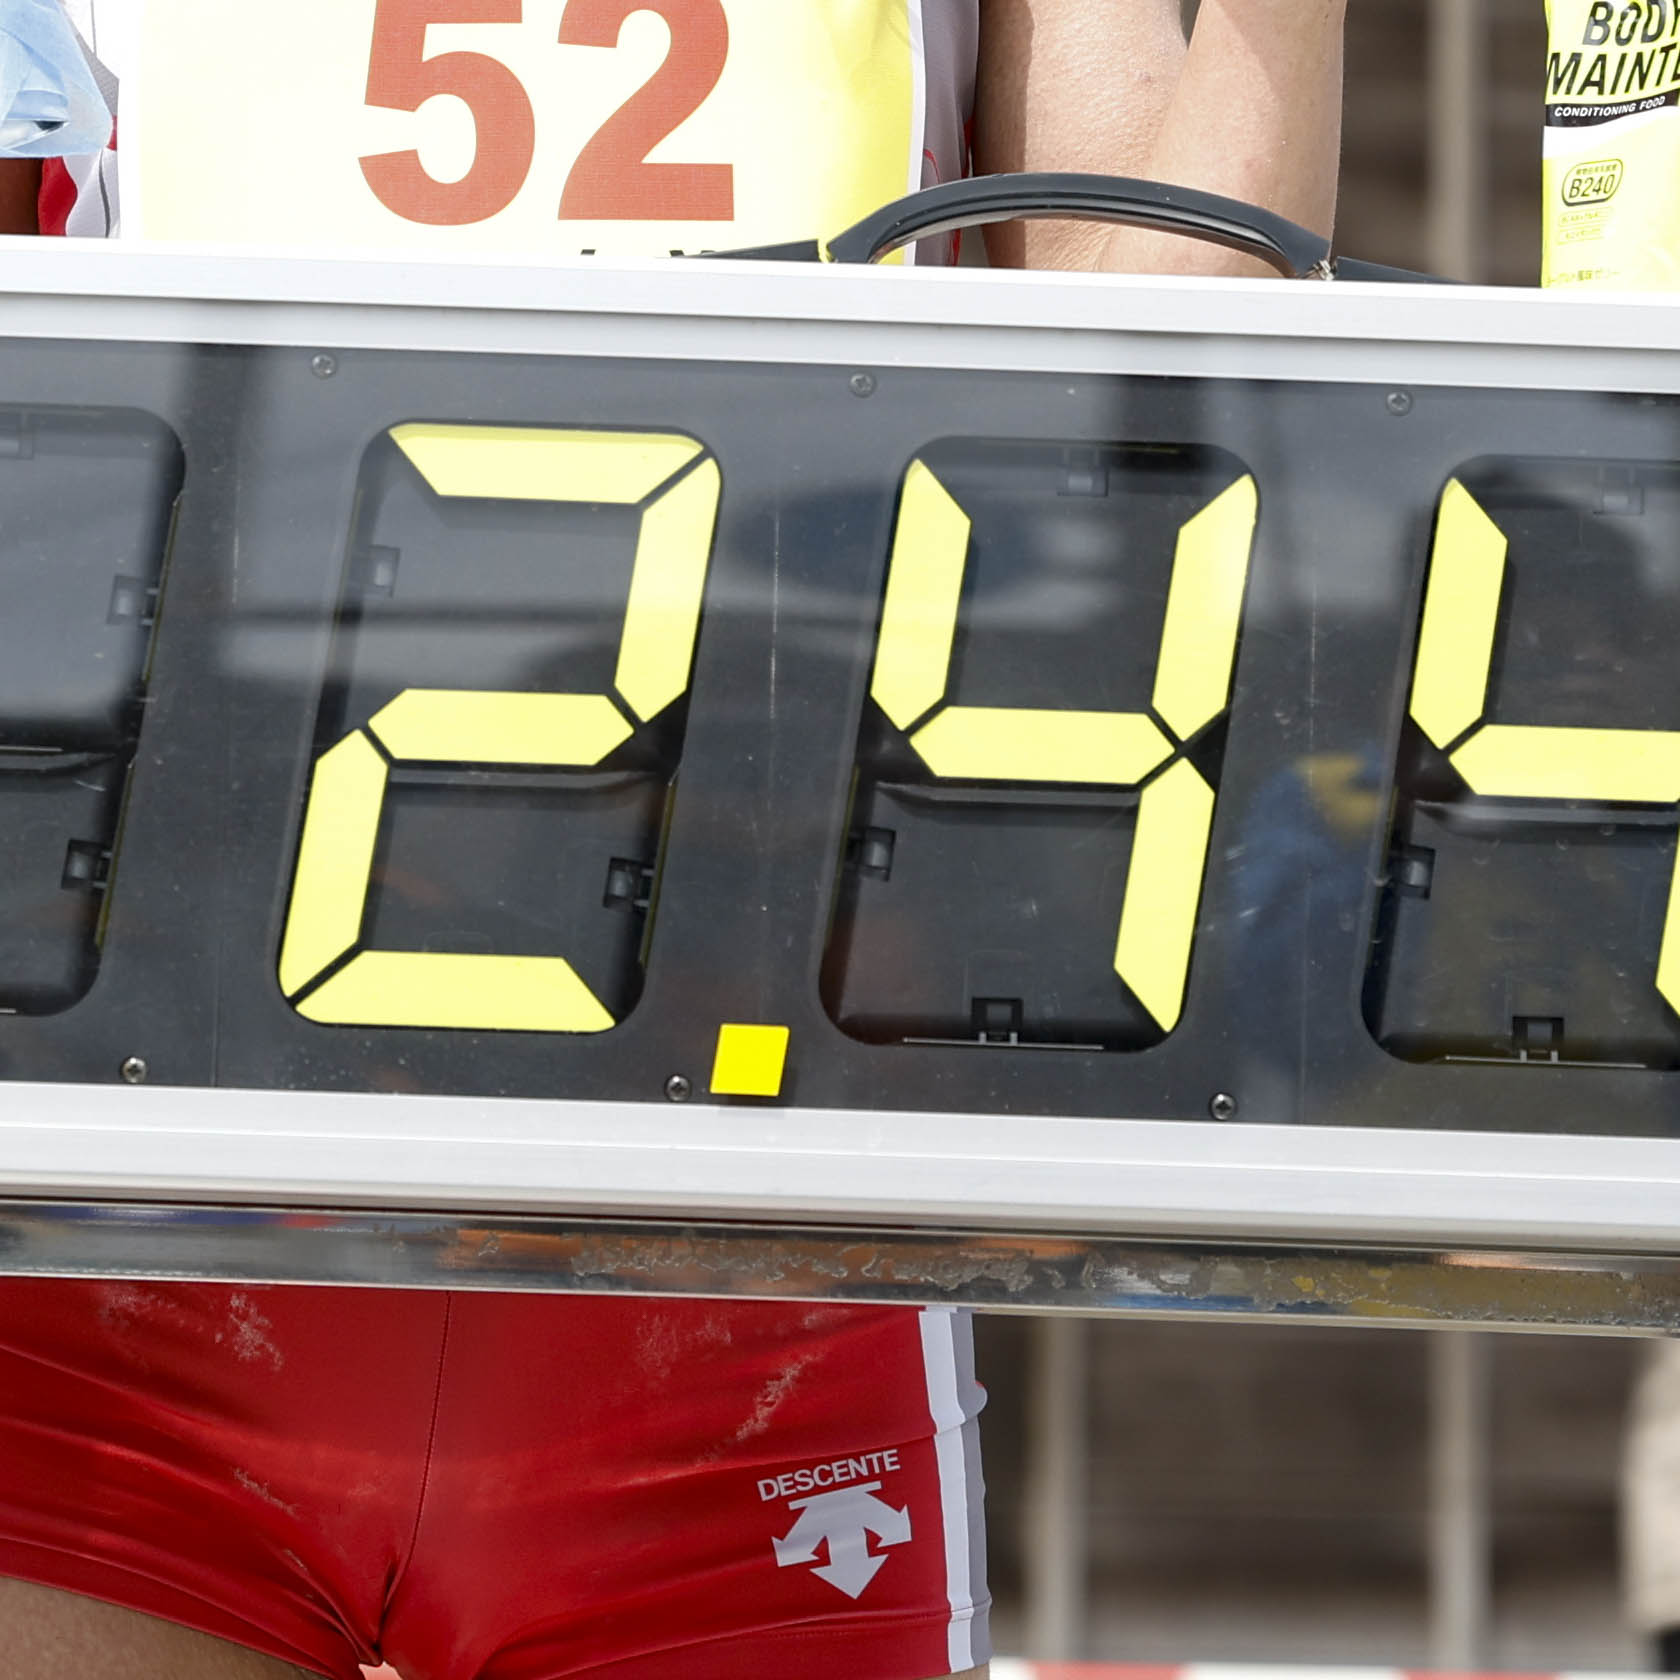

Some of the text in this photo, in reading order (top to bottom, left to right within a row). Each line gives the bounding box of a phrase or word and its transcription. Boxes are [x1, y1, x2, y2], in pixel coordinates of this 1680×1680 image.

[1554, 95, 1666, 117] CONDITIONING FOOD
[1569, 174, 1615, 198] B240
[757, 1449, 901, 1502] DESCENTE
